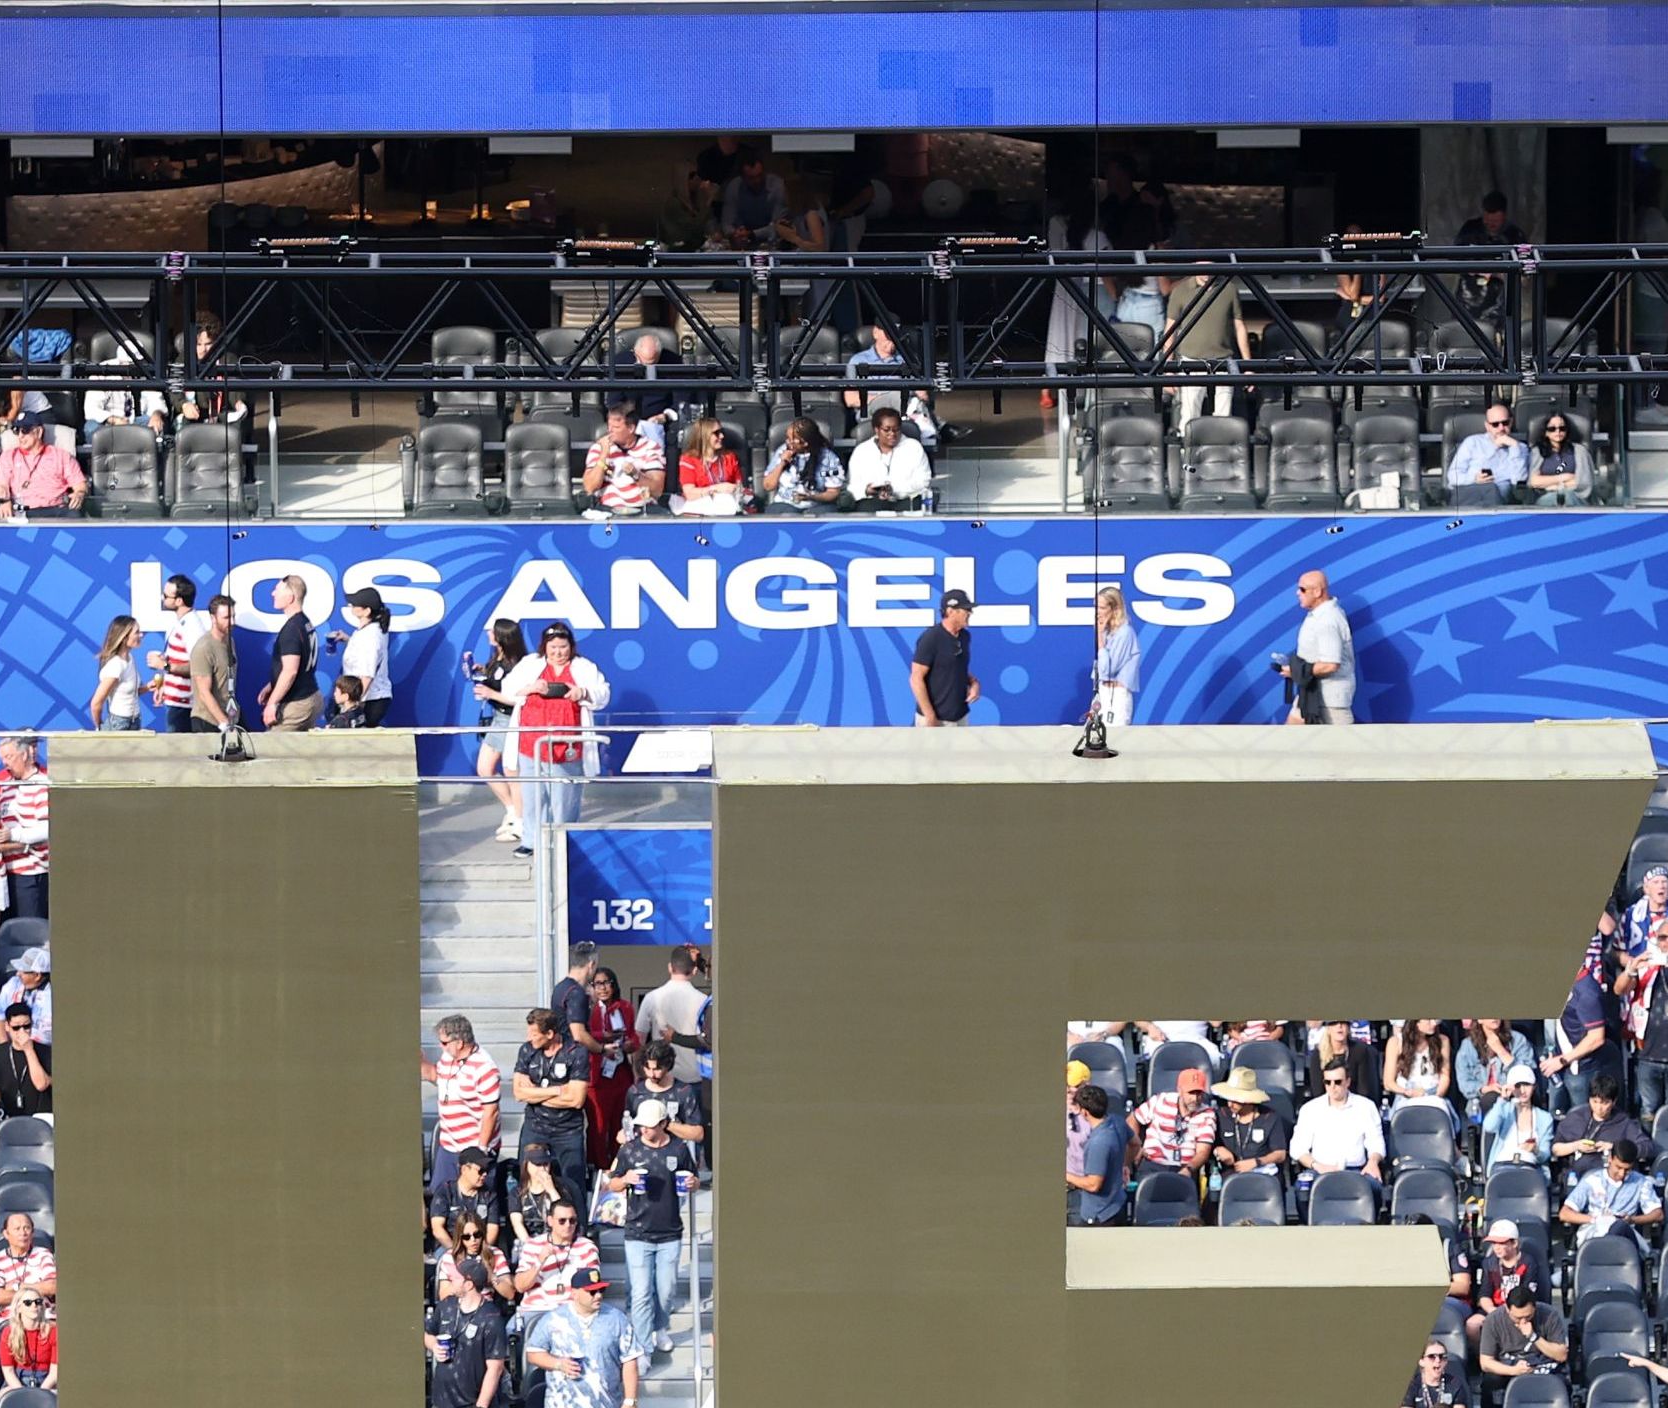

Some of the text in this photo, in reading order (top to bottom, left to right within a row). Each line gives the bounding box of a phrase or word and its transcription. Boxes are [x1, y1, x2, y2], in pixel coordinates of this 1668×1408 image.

[130, 554, 1234, 633] LOS ANGELES
[592, 898, 655, 931] 132
